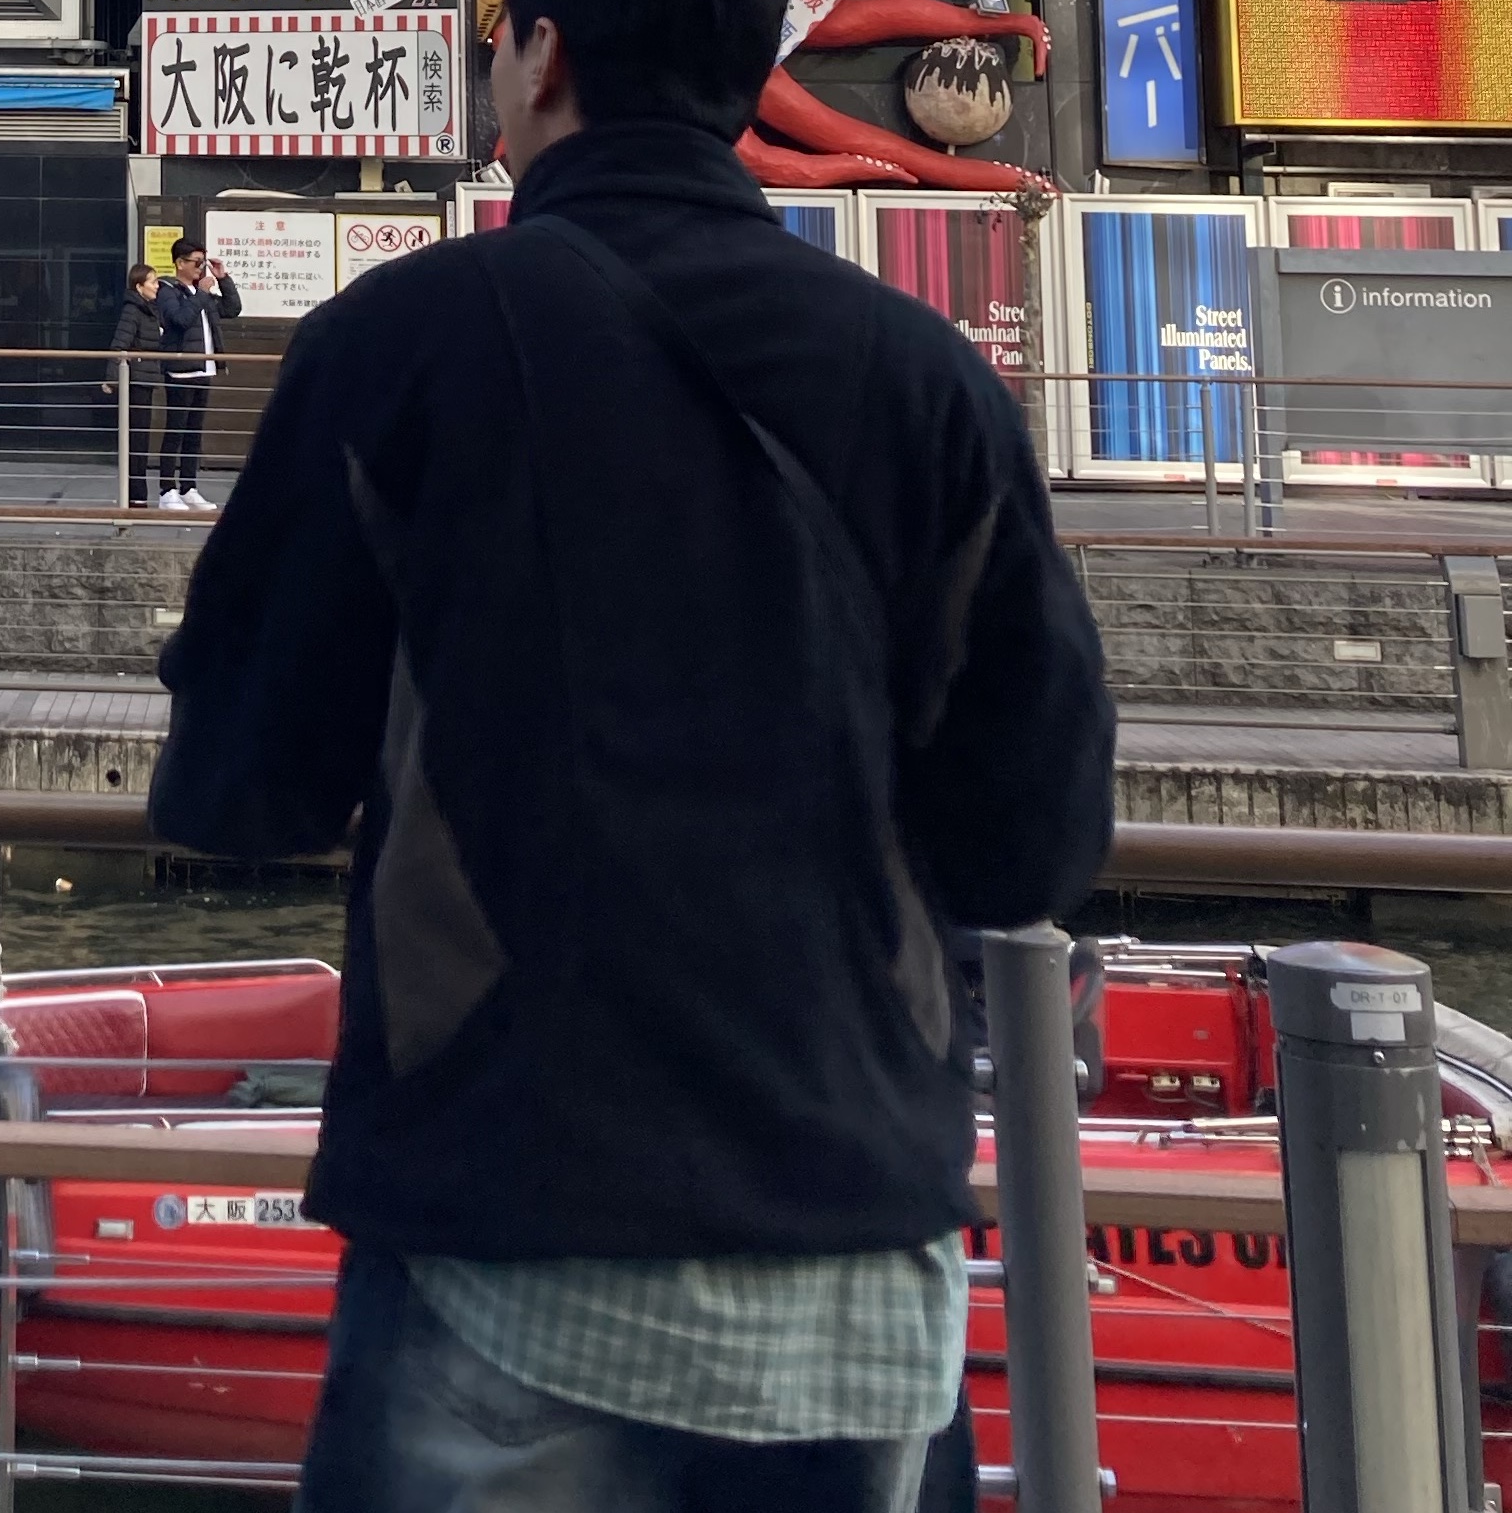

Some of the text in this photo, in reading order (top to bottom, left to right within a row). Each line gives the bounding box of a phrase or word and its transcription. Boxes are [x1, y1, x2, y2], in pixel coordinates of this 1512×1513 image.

[161, 34, 410, 133] 大阪に乾杯
[422, 50, 444, 113] 検索
[1361, 286, 1492, 309] information
[1195, 304, 1243, 328] Street
[1198, 348, 1253, 371] Panels.
[195, 1198, 249, 1222] 大阪
